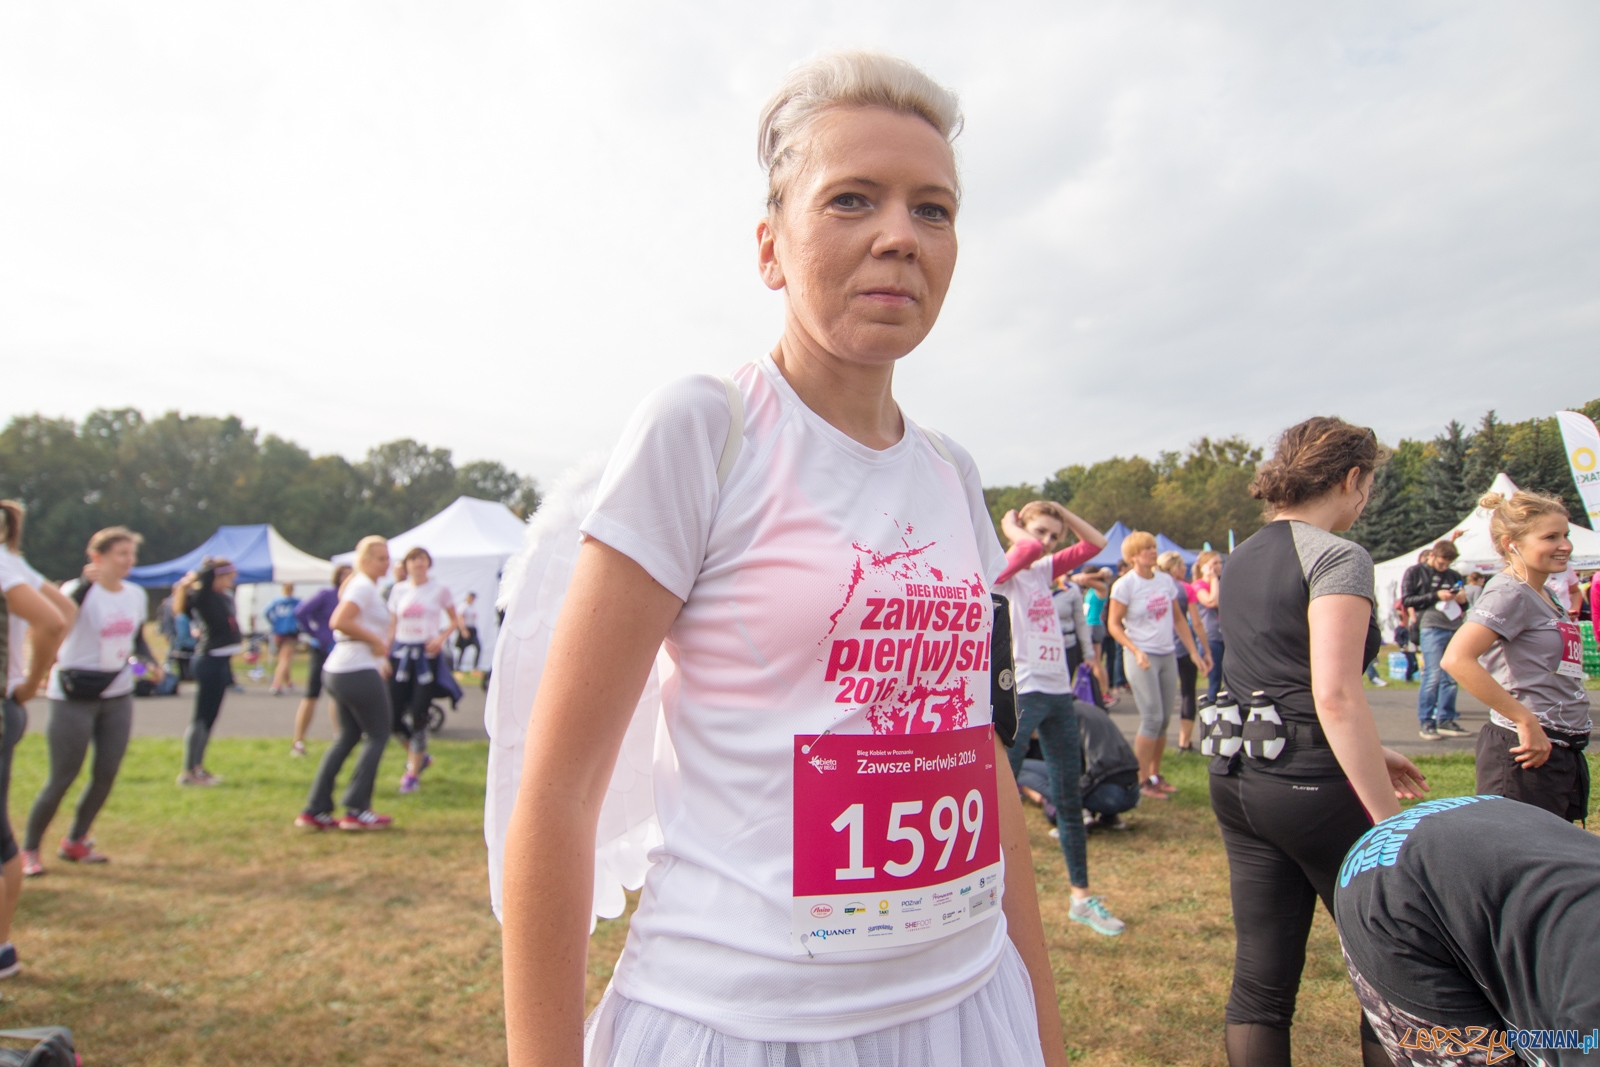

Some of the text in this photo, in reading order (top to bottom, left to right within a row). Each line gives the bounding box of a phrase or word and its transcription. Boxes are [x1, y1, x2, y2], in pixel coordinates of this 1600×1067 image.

[905, 583, 968, 600] BIEG KOBIET
[860, 597, 982, 632] zawsze
[1039, 645, 1061, 662] 217
[834, 676, 899, 704] 2016
[857, 749, 977, 774] Zawsze Pier(w)si 2016
[892, 748, 914, 756] Poznaniu
[830, 788, 984, 881] 1599
[1378, 833, 1409, 867] AND
[905, 918, 932, 929] SHEFOOT
